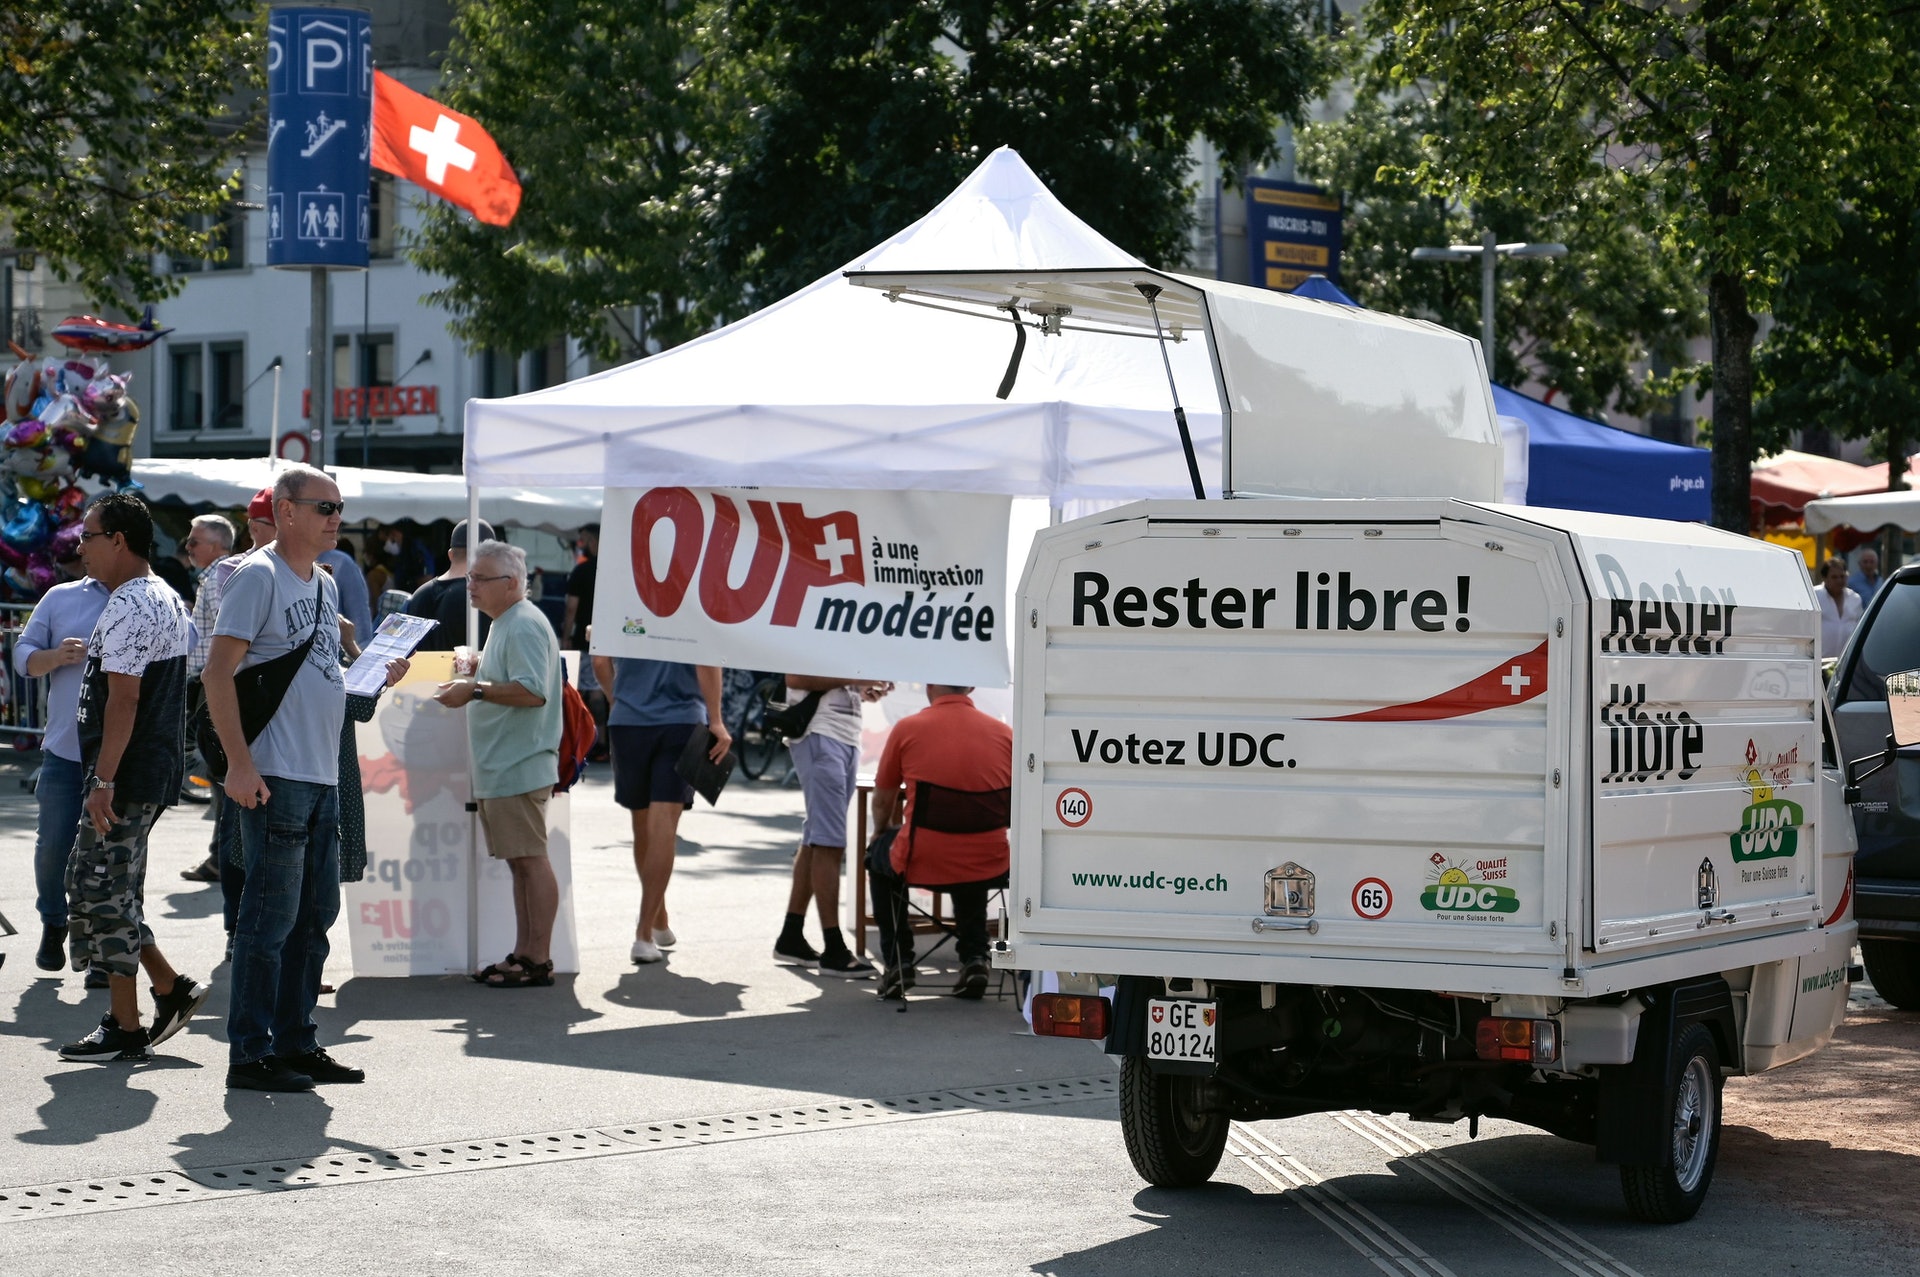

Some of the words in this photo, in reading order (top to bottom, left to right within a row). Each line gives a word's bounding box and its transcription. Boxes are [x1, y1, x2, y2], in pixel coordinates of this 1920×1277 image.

[306, 38, 343, 88] P
[302, 385, 438, 419] RIFFEISEN
[872, 535, 883, 558] à
[887, 542, 919, 561] une
[873, 560, 984, 591] immigration
[1072, 571, 1277, 629] Rester
[1295, 571, 1471, 633] libre!
[1595, 553, 1738, 655] Rester
[814, 590, 994, 642] modérée
[1601, 683, 1704, 783] libre
[1071, 729, 1186, 766] Votez
[1197, 731, 1297, 769] UDC.
[1062, 799, 1086, 816] 140
[1741, 805, 1793, 856] UDC
[1476, 856, 1507, 871] QUALITÉ
[1482, 869, 1507, 881] SUISSE
[1741, 869, 1752, 883] Pour
[1753, 870, 1761, 882] une
[1762, 867, 1777, 881] Suisse
[1777, 865, 1788, 879] forte
[1071, 870, 1228, 895] www.udc-ge.ch
[1359, 888, 1384, 910] 65
[1436, 886, 1498, 910] UDC
[1436, 913, 1452, 921] Pour
[1466, 914, 1487, 922] Suisse
[1169, 1003, 1197, 1029] GE
[1150, 1031, 1214, 1059] 80124
